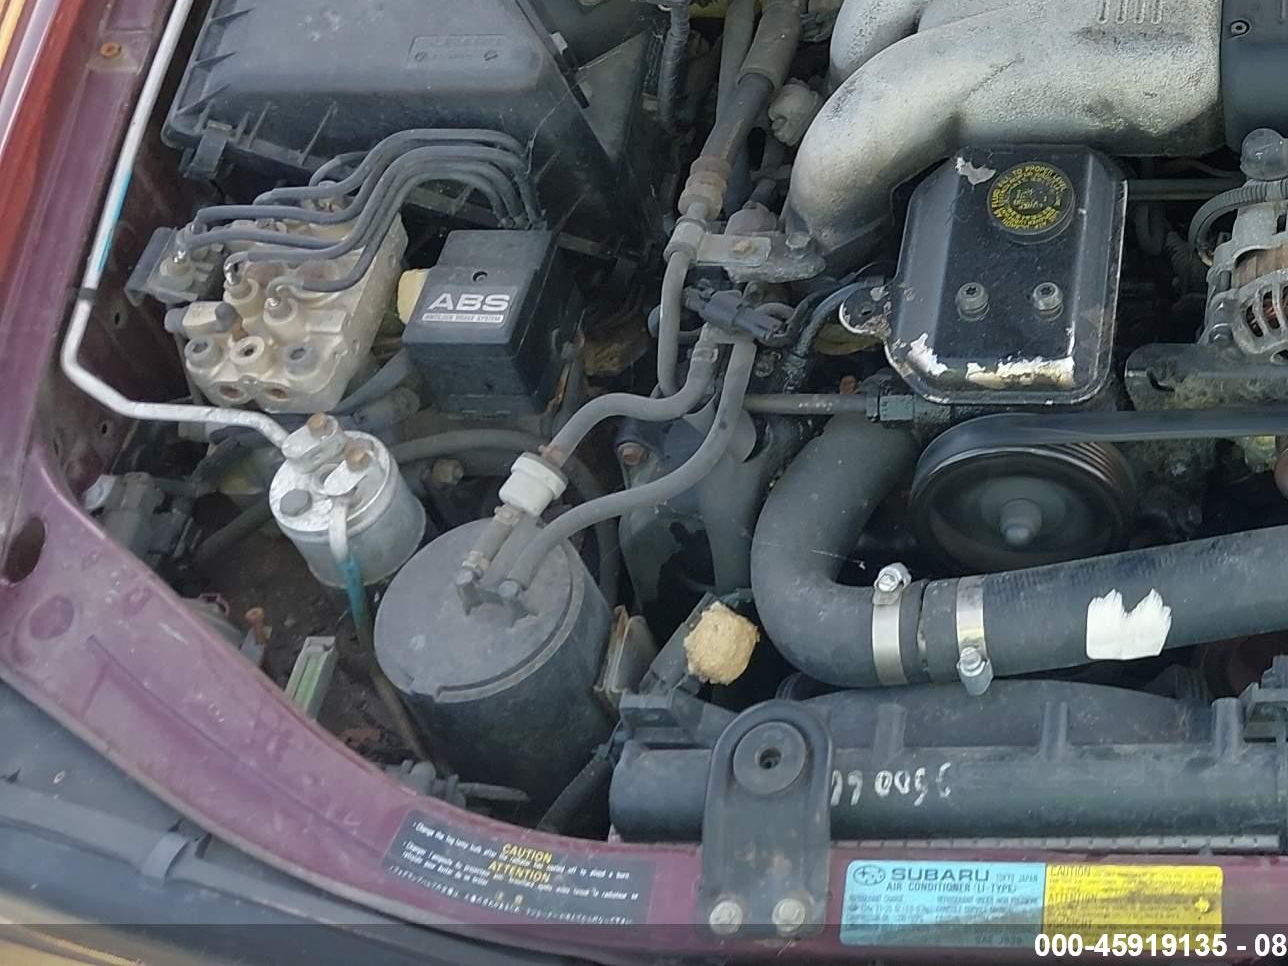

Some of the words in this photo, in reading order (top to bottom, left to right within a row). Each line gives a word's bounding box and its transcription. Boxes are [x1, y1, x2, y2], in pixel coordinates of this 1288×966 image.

[428, 293, 510, 312] ABS
[502, 843, 553, 864] CAUTION
[487, 859, 552, 884] ATTENTION
[891, 869, 990, 882] SUBARU
[1051, 865, 1092, 876] CAUTION
[886, 883, 902, 892] AIR
[908, 883, 971, 892] CONDITIONER
